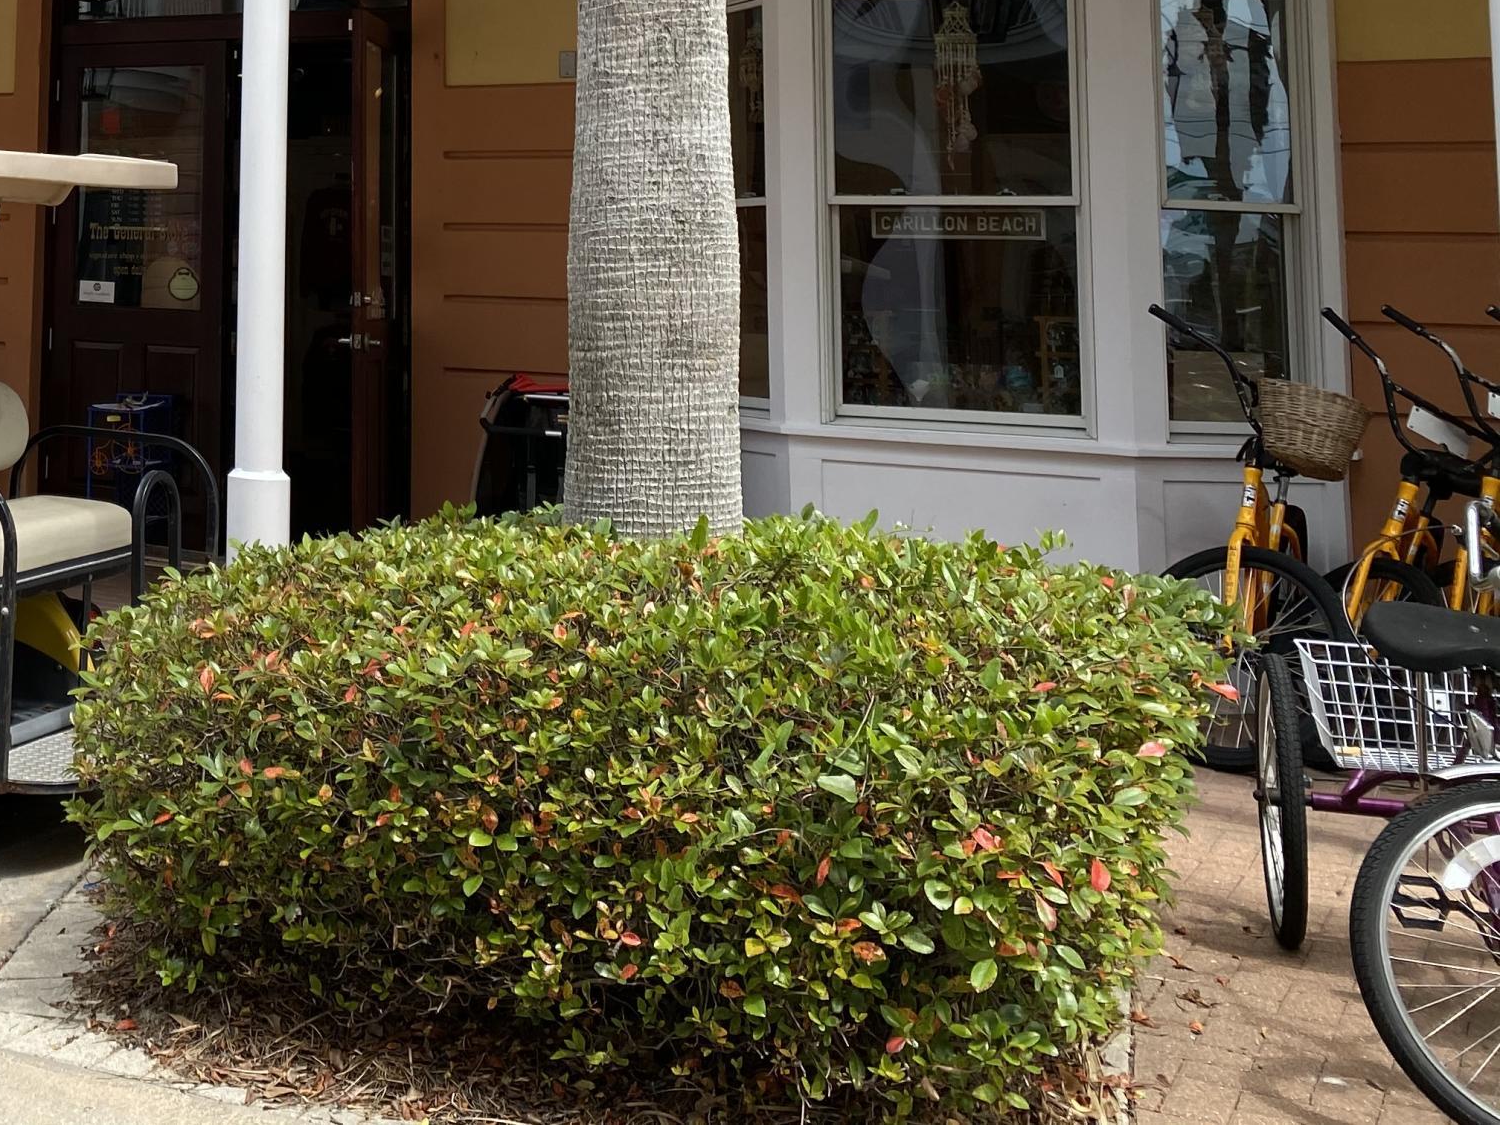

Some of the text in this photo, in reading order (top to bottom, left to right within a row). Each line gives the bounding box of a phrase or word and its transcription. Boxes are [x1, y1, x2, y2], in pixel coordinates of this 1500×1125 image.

[90, 222, 109, 240] The
[113, 223, 156, 241] General
[880, 216, 1037, 233] CARILLON BEACH
